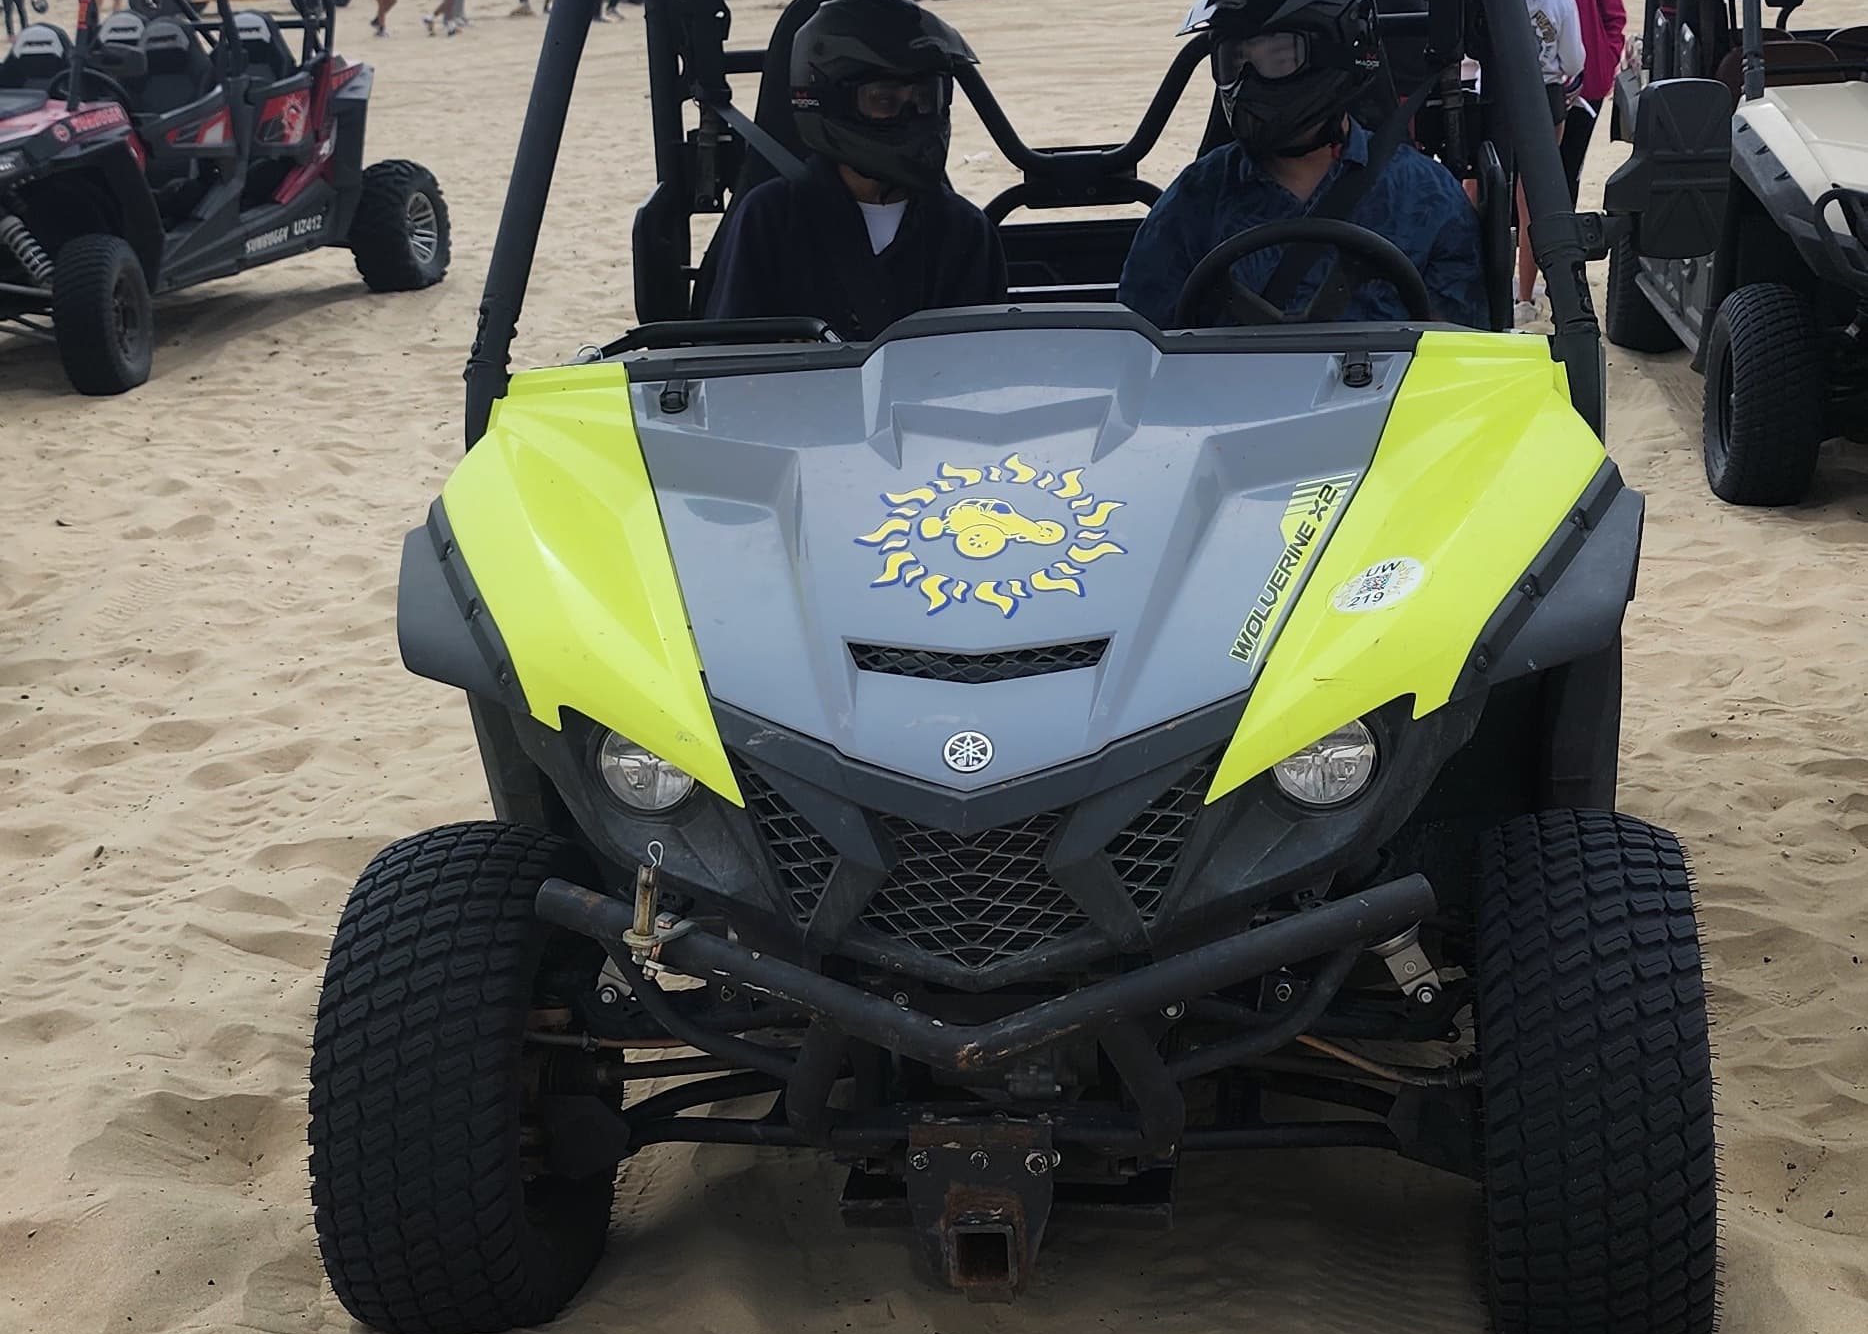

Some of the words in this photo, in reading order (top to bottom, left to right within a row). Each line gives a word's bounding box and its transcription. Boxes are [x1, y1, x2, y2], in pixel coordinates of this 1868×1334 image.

[294, 214, 322, 236] UZ412
[1231, 520, 1316, 661] WOLVERINE
[1308, 483, 1338, 522] X2
[1366, 560, 1402, 577] UW
[1347, 591, 1384, 607] 219
